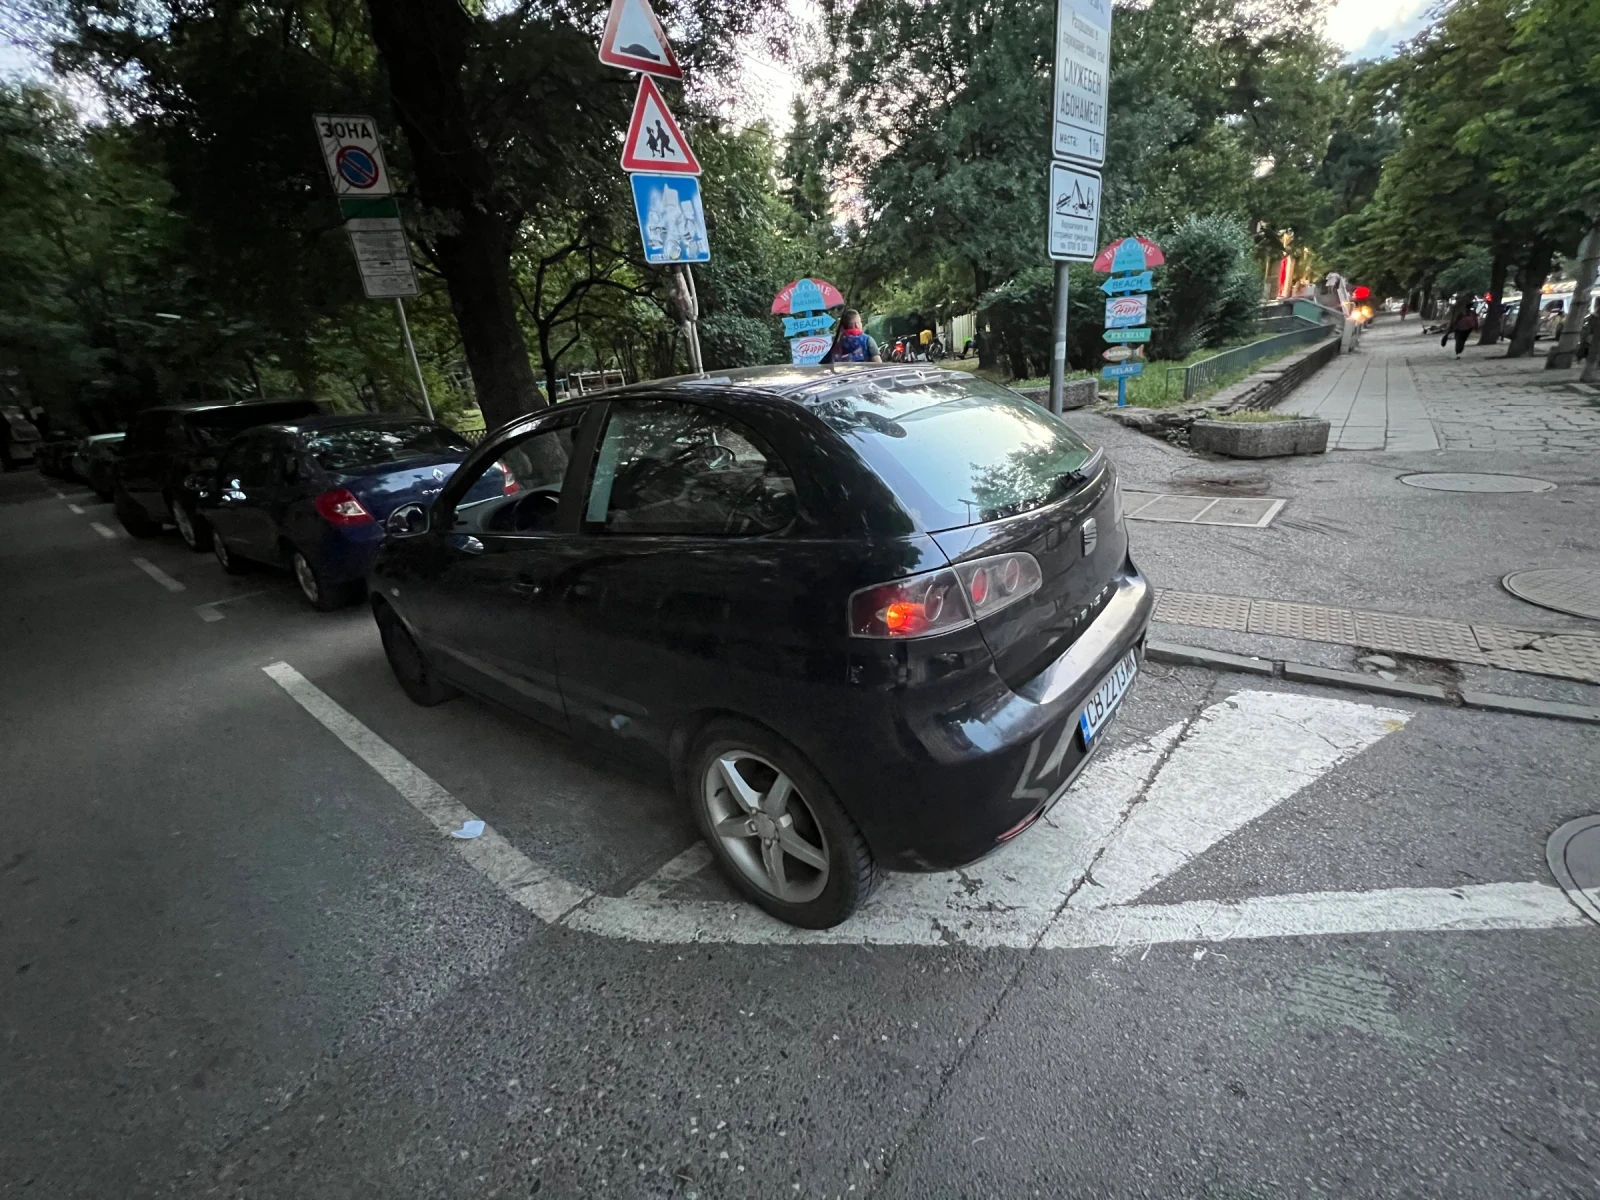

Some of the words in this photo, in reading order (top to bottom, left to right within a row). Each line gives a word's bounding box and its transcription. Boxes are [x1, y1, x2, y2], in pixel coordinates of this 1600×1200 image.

[1063, 57, 1102, 96] СЛУЖЕБЕН
[1060, 91, 1103, 127] АБОНАМЕНТ
[319, 122, 372, 140] ЗОНА
[1104, 241, 1155, 260] WELCOME
[1112, 278, 1143, 290] BEACH
[780, 283, 831, 301] WELCOME
[1113, 304, 1140, 315] Happy
[793, 318, 824, 331] BEACH
[1122, 331, 1145, 339] CREAM
[799, 343, 826, 355] Happy
[1111, 366, 1134, 375] RELAX
